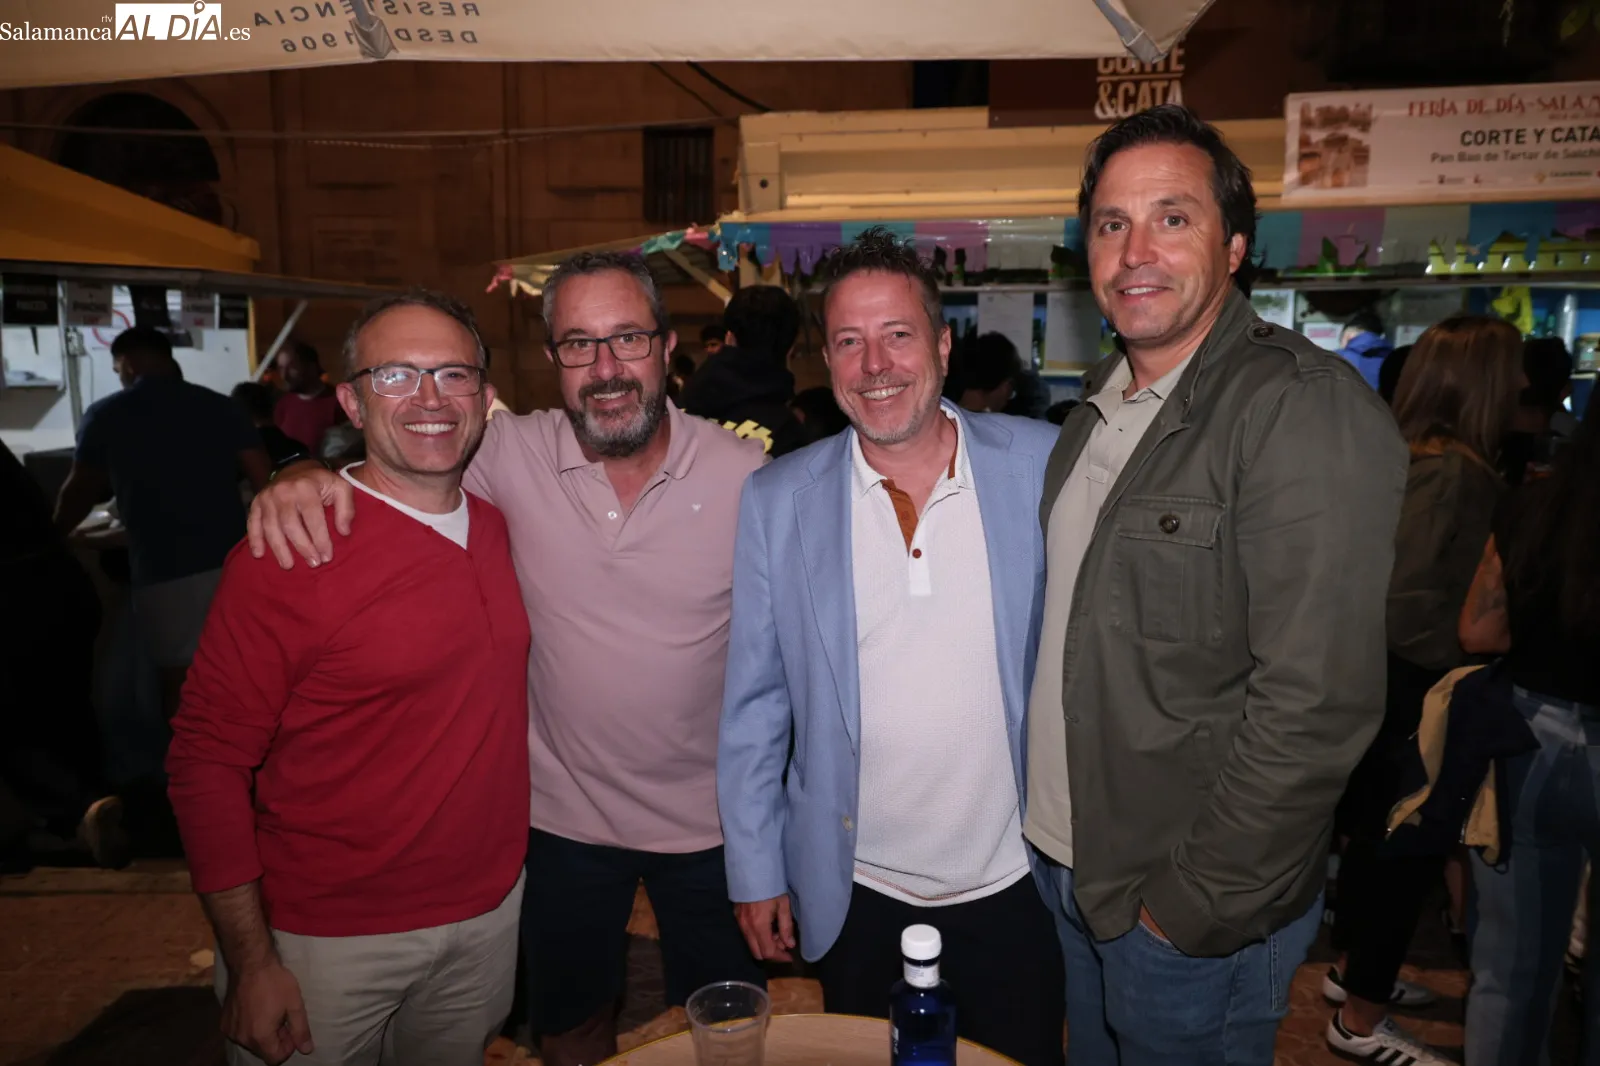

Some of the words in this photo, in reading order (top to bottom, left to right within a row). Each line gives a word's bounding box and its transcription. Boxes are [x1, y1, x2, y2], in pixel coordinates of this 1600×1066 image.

[1409, 97, 1458, 118] FERIA
[1467, 98, 1488, 115] DE
[1460, 128, 1527, 148] CORTE
[1533, 128, 1546, 144] Y
[1551, 126, 1600, 144] CATA
